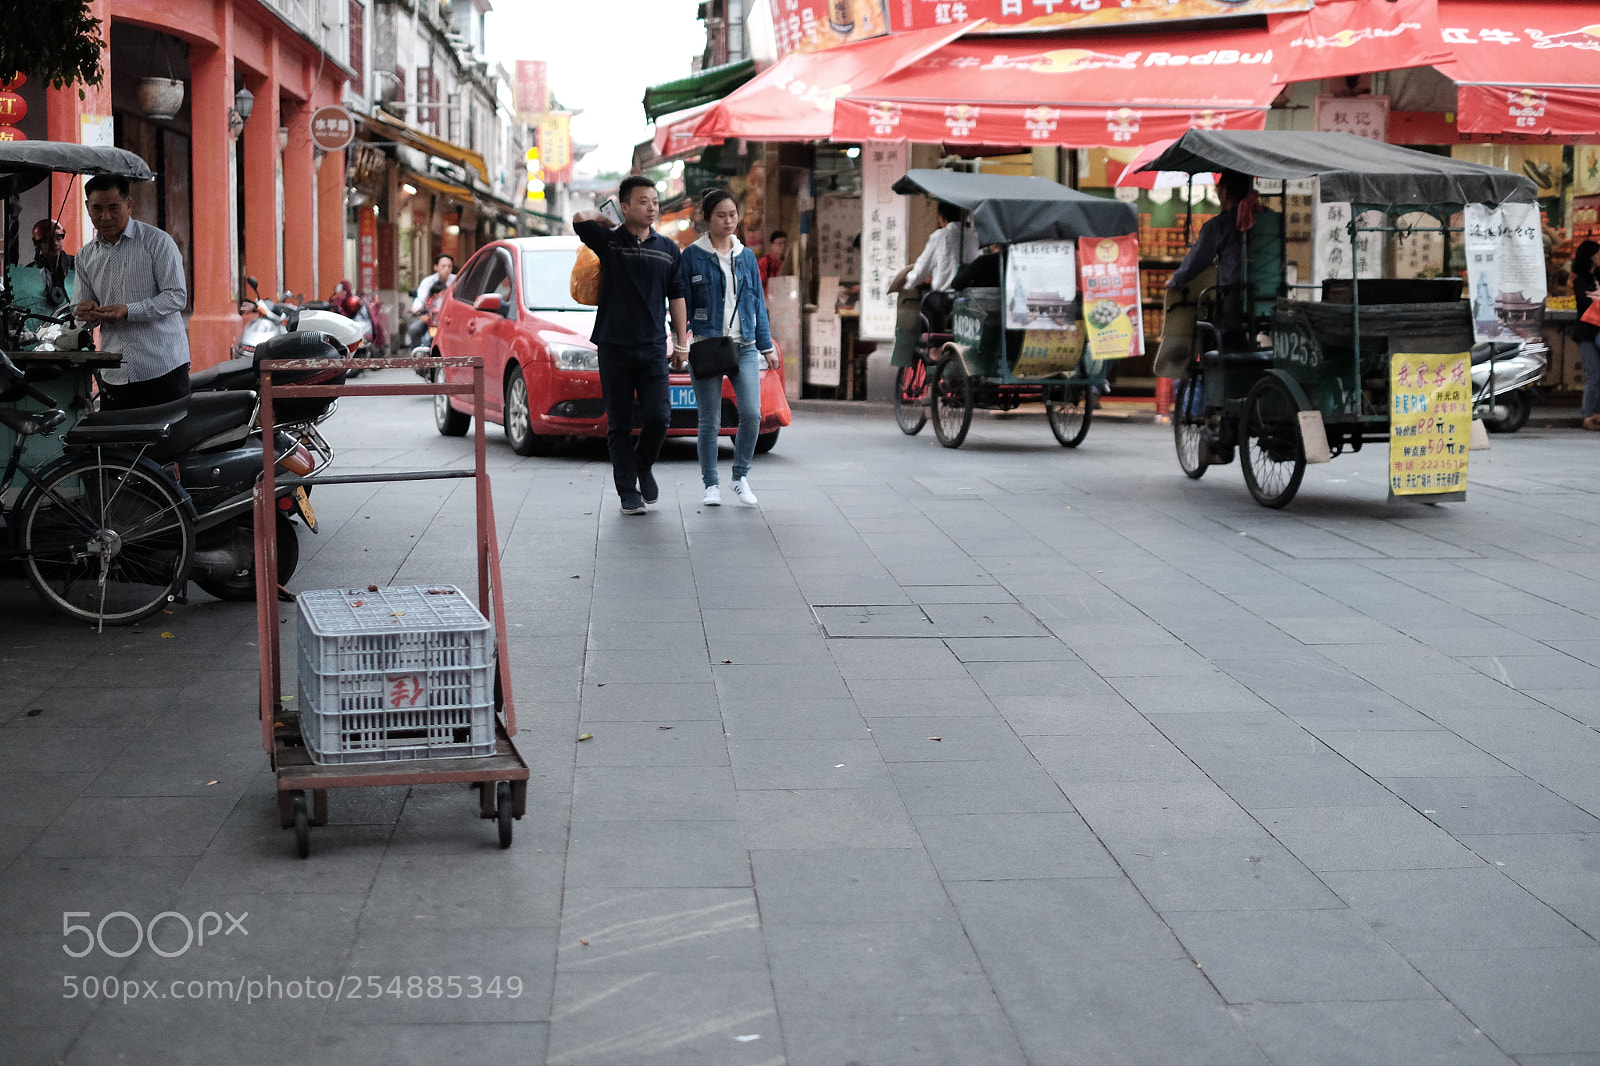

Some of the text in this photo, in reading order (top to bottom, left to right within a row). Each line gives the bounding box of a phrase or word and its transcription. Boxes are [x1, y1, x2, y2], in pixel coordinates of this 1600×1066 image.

[934, 3, 969, 24] 红牛
[1143, 49, 1273, 67] RedBul
[1333, 110, 1372, 125] 权记
[1508, 106, 1545, 117] RedBull
